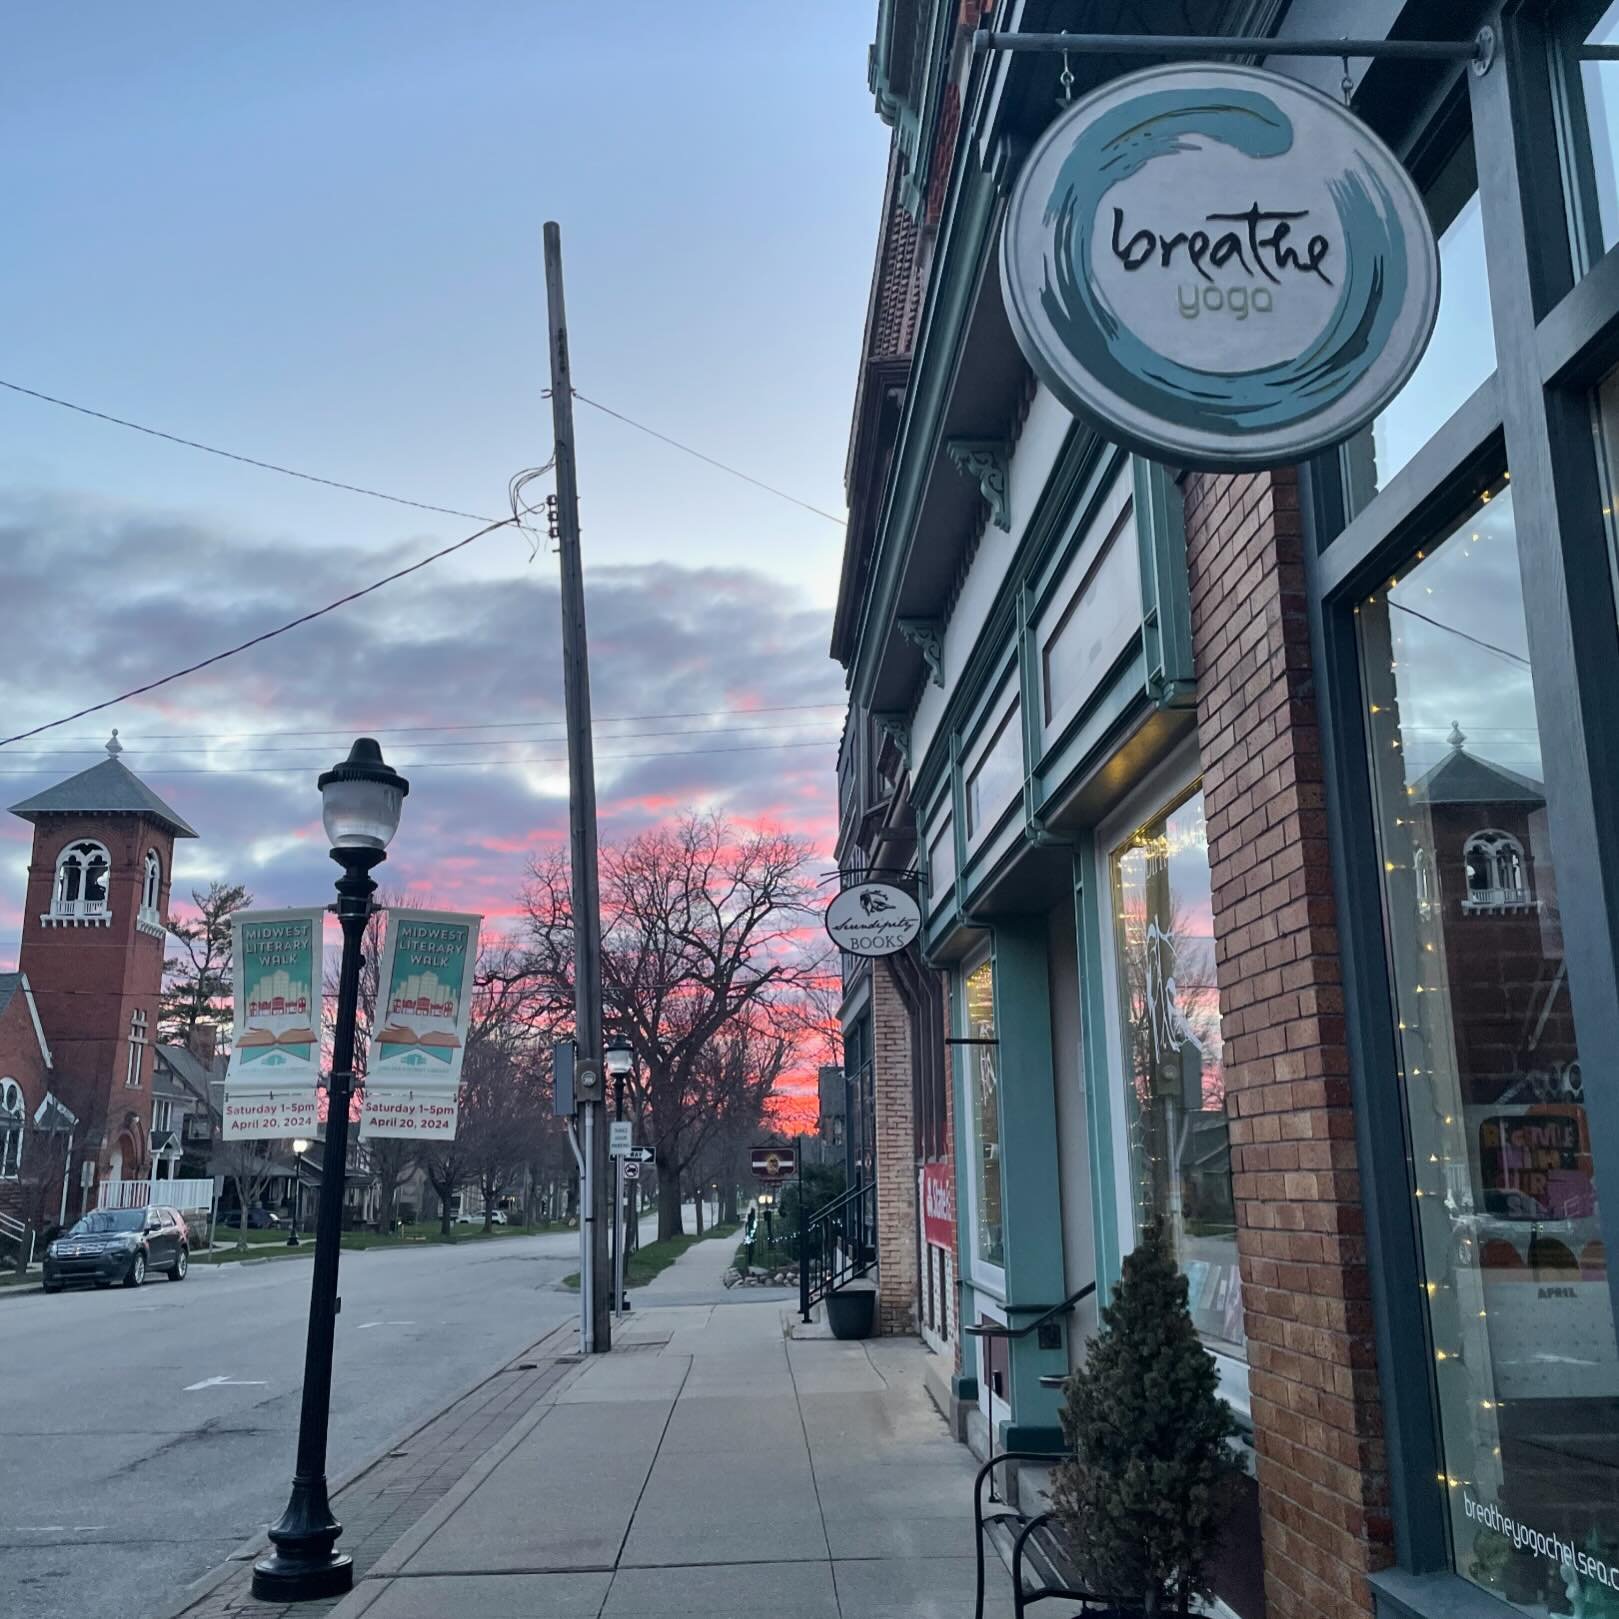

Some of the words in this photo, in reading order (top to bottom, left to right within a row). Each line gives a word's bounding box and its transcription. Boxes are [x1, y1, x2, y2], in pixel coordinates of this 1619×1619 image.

[1111, 201, 1334, 287] breathe
[1177, 283, 1273, 320] yoga
[246, 926, 308, 940] MIDWEST
[401, 927, 464, 941] MIDWEST
[245, 939, 309, 953] LITERARY
[399, 940, 464, 954] LITERARY
[850, 934, 905, 950] BOOKS
[259, 954, 297, 967] WALK
[410, 954, 449, 967] WALK
[226, 1104, 277, 1116] Saturday
[281, 1103, 315, 1114] 1-5pm
[365, 1102, 416, 1116] Saturday
[419, 1105, 454, 1116] 1-5pm
[231, 1119, 259, 1131] April
[262, 1118, 280, 1129] 20,
[283, 1117, 312, 1127] 2024
[369, 1117, 397, 1128] April
[399, 1119, 417, 1129] 20,
[420, 1119, 449, 1129] 2024
